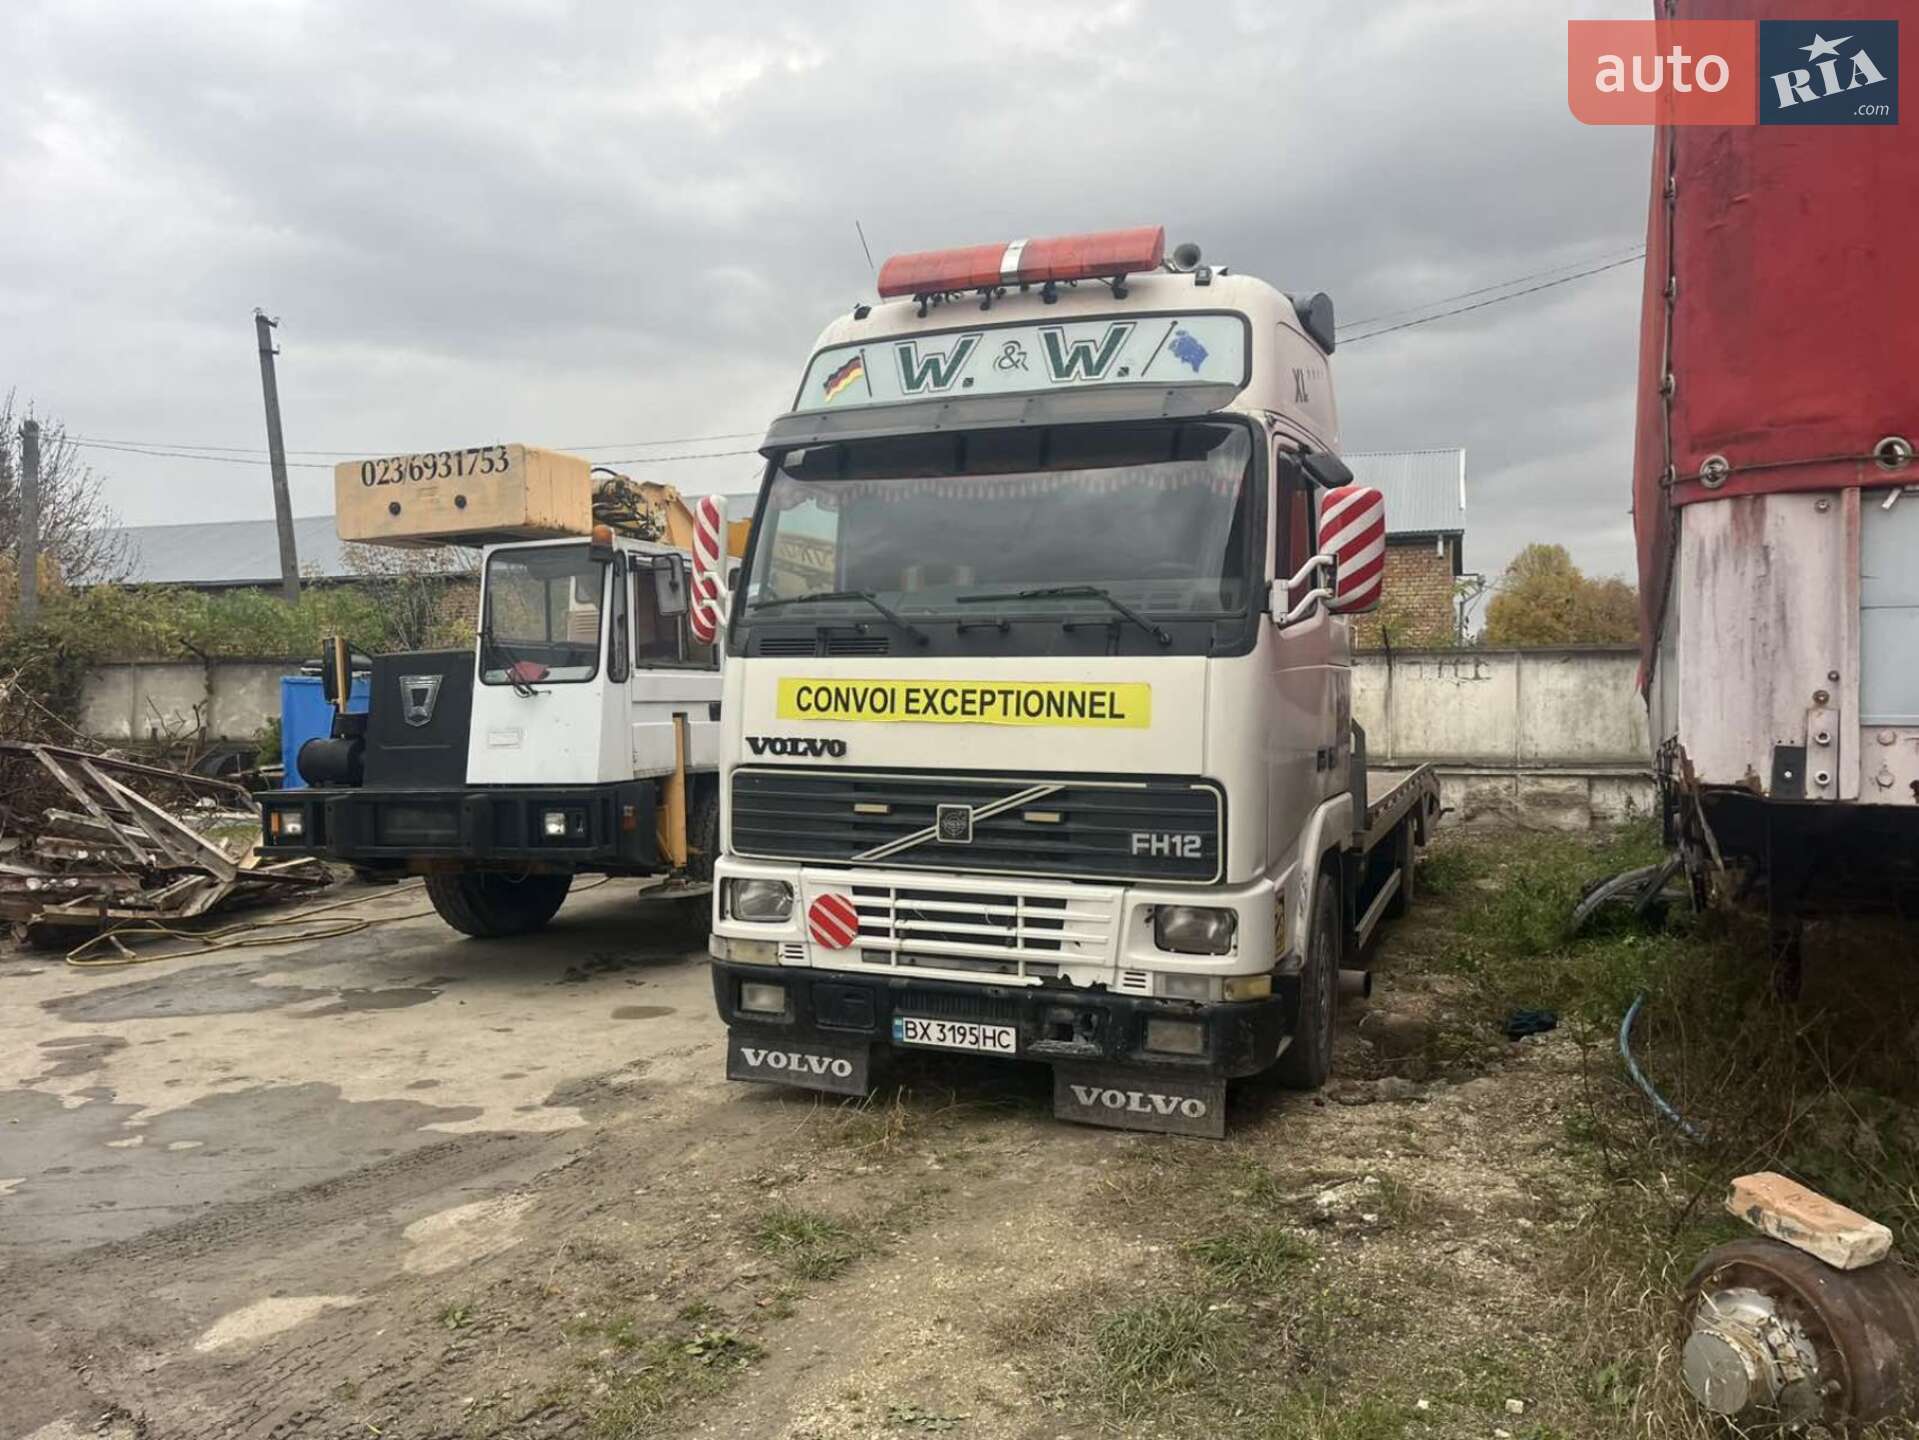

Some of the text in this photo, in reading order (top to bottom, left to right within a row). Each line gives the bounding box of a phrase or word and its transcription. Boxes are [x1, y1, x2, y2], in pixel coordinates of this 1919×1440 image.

[992, 340, 1028, 371] &
[796, 685, 1125, 720] CONVOI EXCEPTIONNEL
[746, 735, 847, 759] VOLVO
[1131, 832, 1202, 859] FH12
[741, 1047, 853, 1078] VOLVO
[1070, 1084, 1208, 1119] VOLVO
